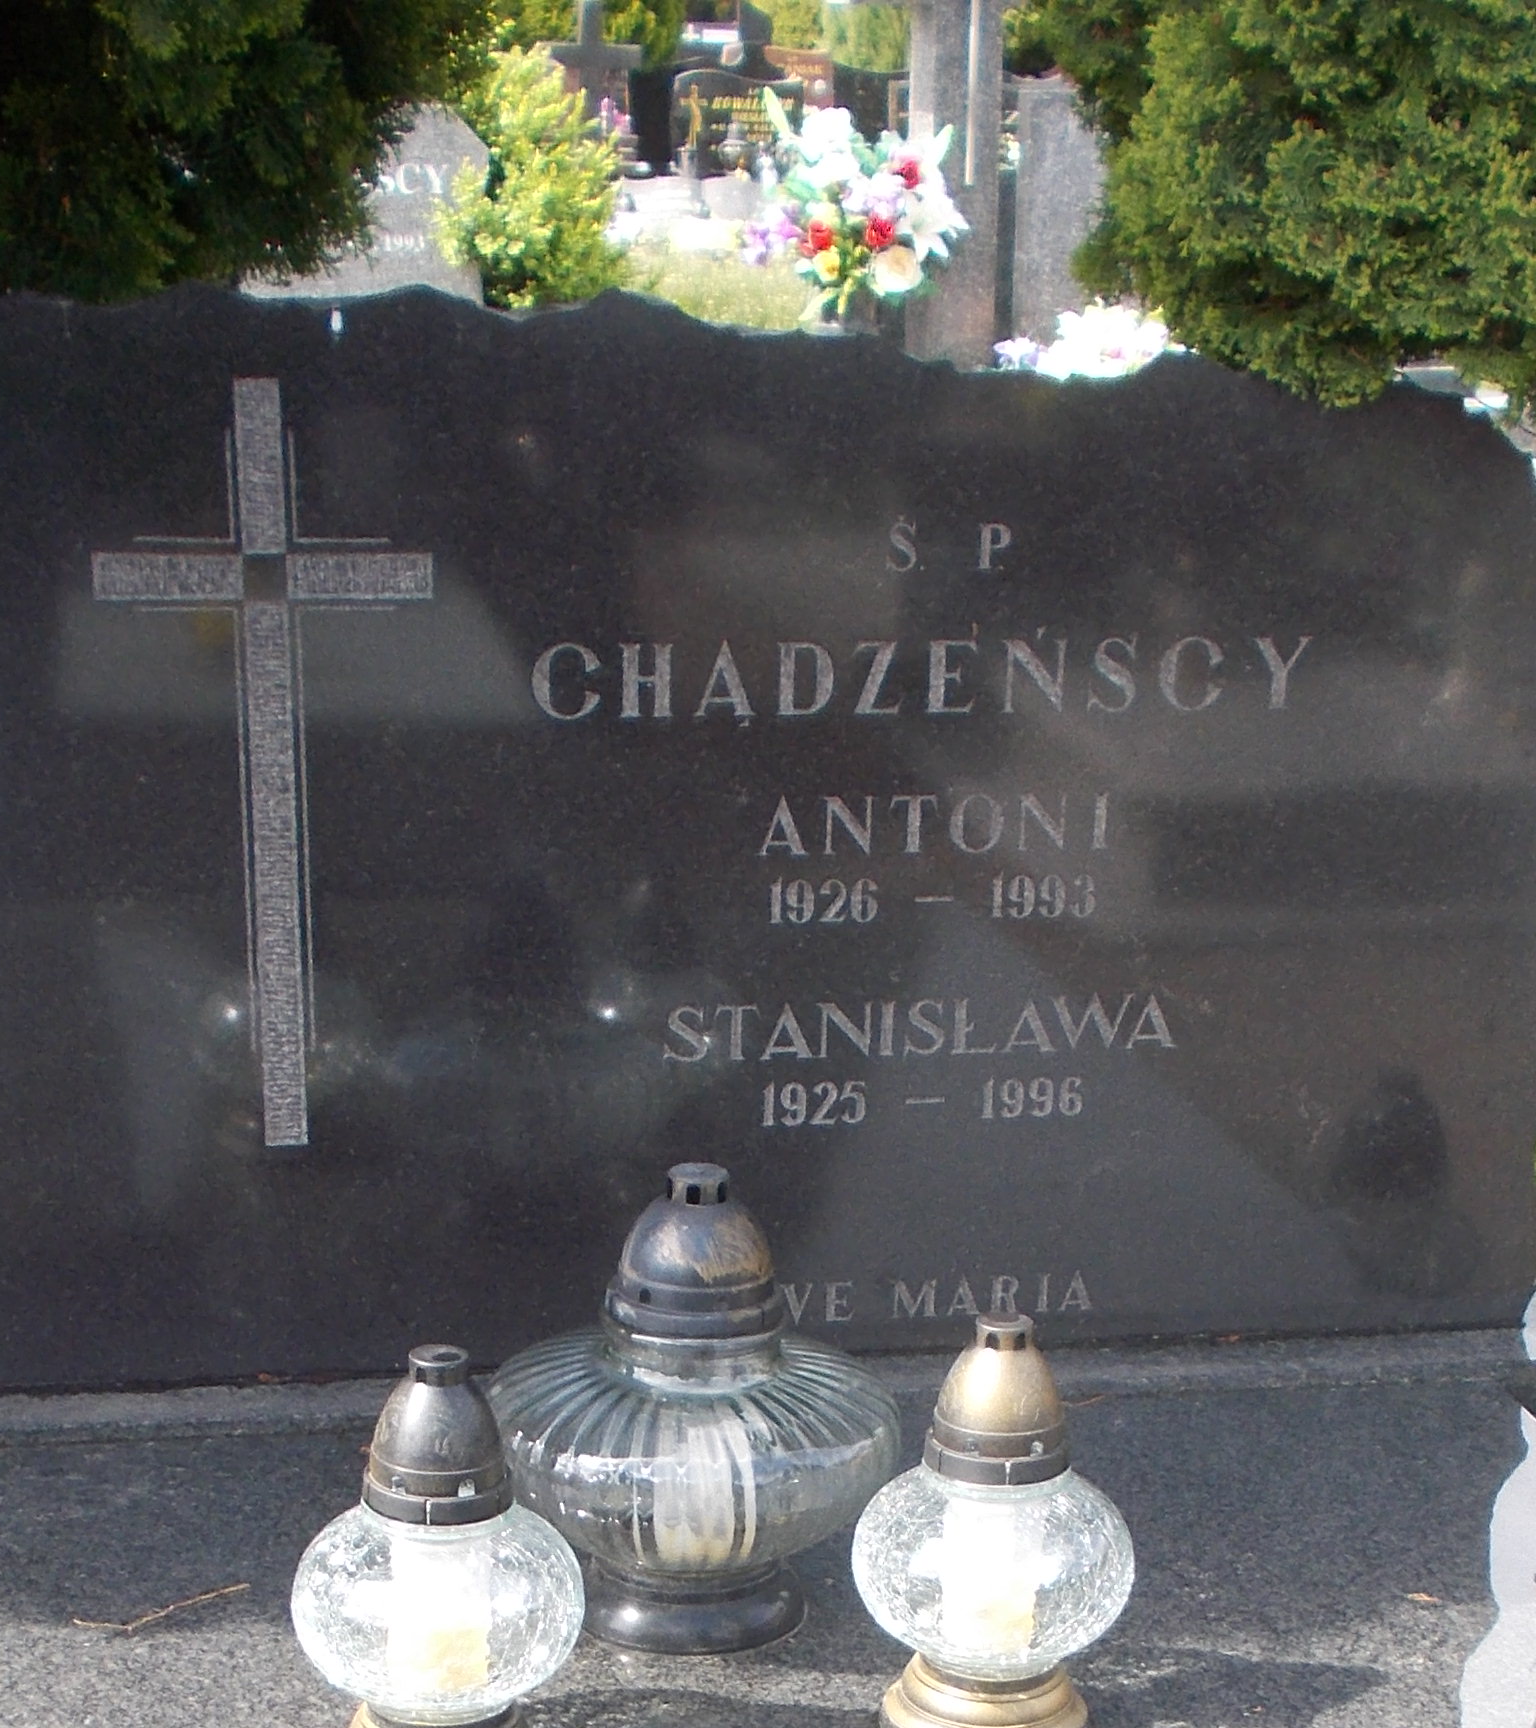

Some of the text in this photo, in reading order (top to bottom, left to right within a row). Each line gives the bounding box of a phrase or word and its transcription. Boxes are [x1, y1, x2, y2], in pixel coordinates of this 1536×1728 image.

[755, 792, 1112, 856] ANTONI
[769, 877, 879, 924] 1926
[991, 870, 1096, 918] 1993
[663, 992, 1178, 1061] STANISŁAWA
[761, 1079, 867, 1127] 1925
[981, 1075, 1084, 1120] 1996
[779, 1268, 1094, 1326] VE MARIA
